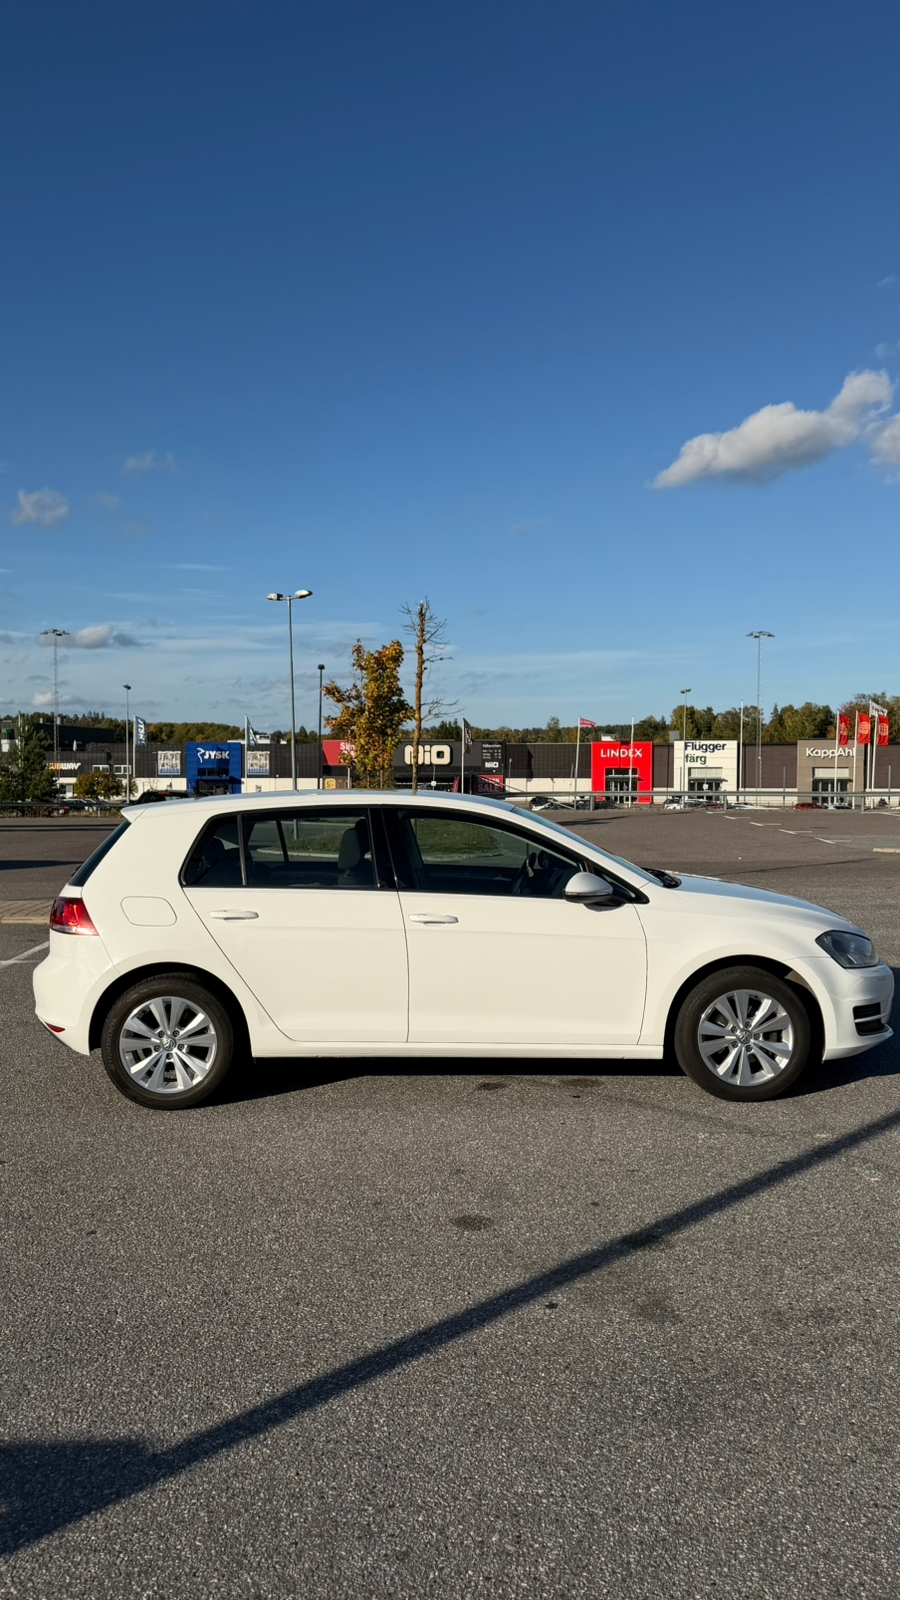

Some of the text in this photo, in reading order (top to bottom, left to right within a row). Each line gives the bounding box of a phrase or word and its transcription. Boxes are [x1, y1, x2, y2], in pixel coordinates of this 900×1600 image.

[685, 741, 727, 753] Flügger
[204, 751, 229, 759] JYSK
[600, 748, 643, 758] LINDEX
[806, 747, 855, 759] KappAhl
[685, 753, 707, 765] färg
[478, 784, 500, 793] SALE
